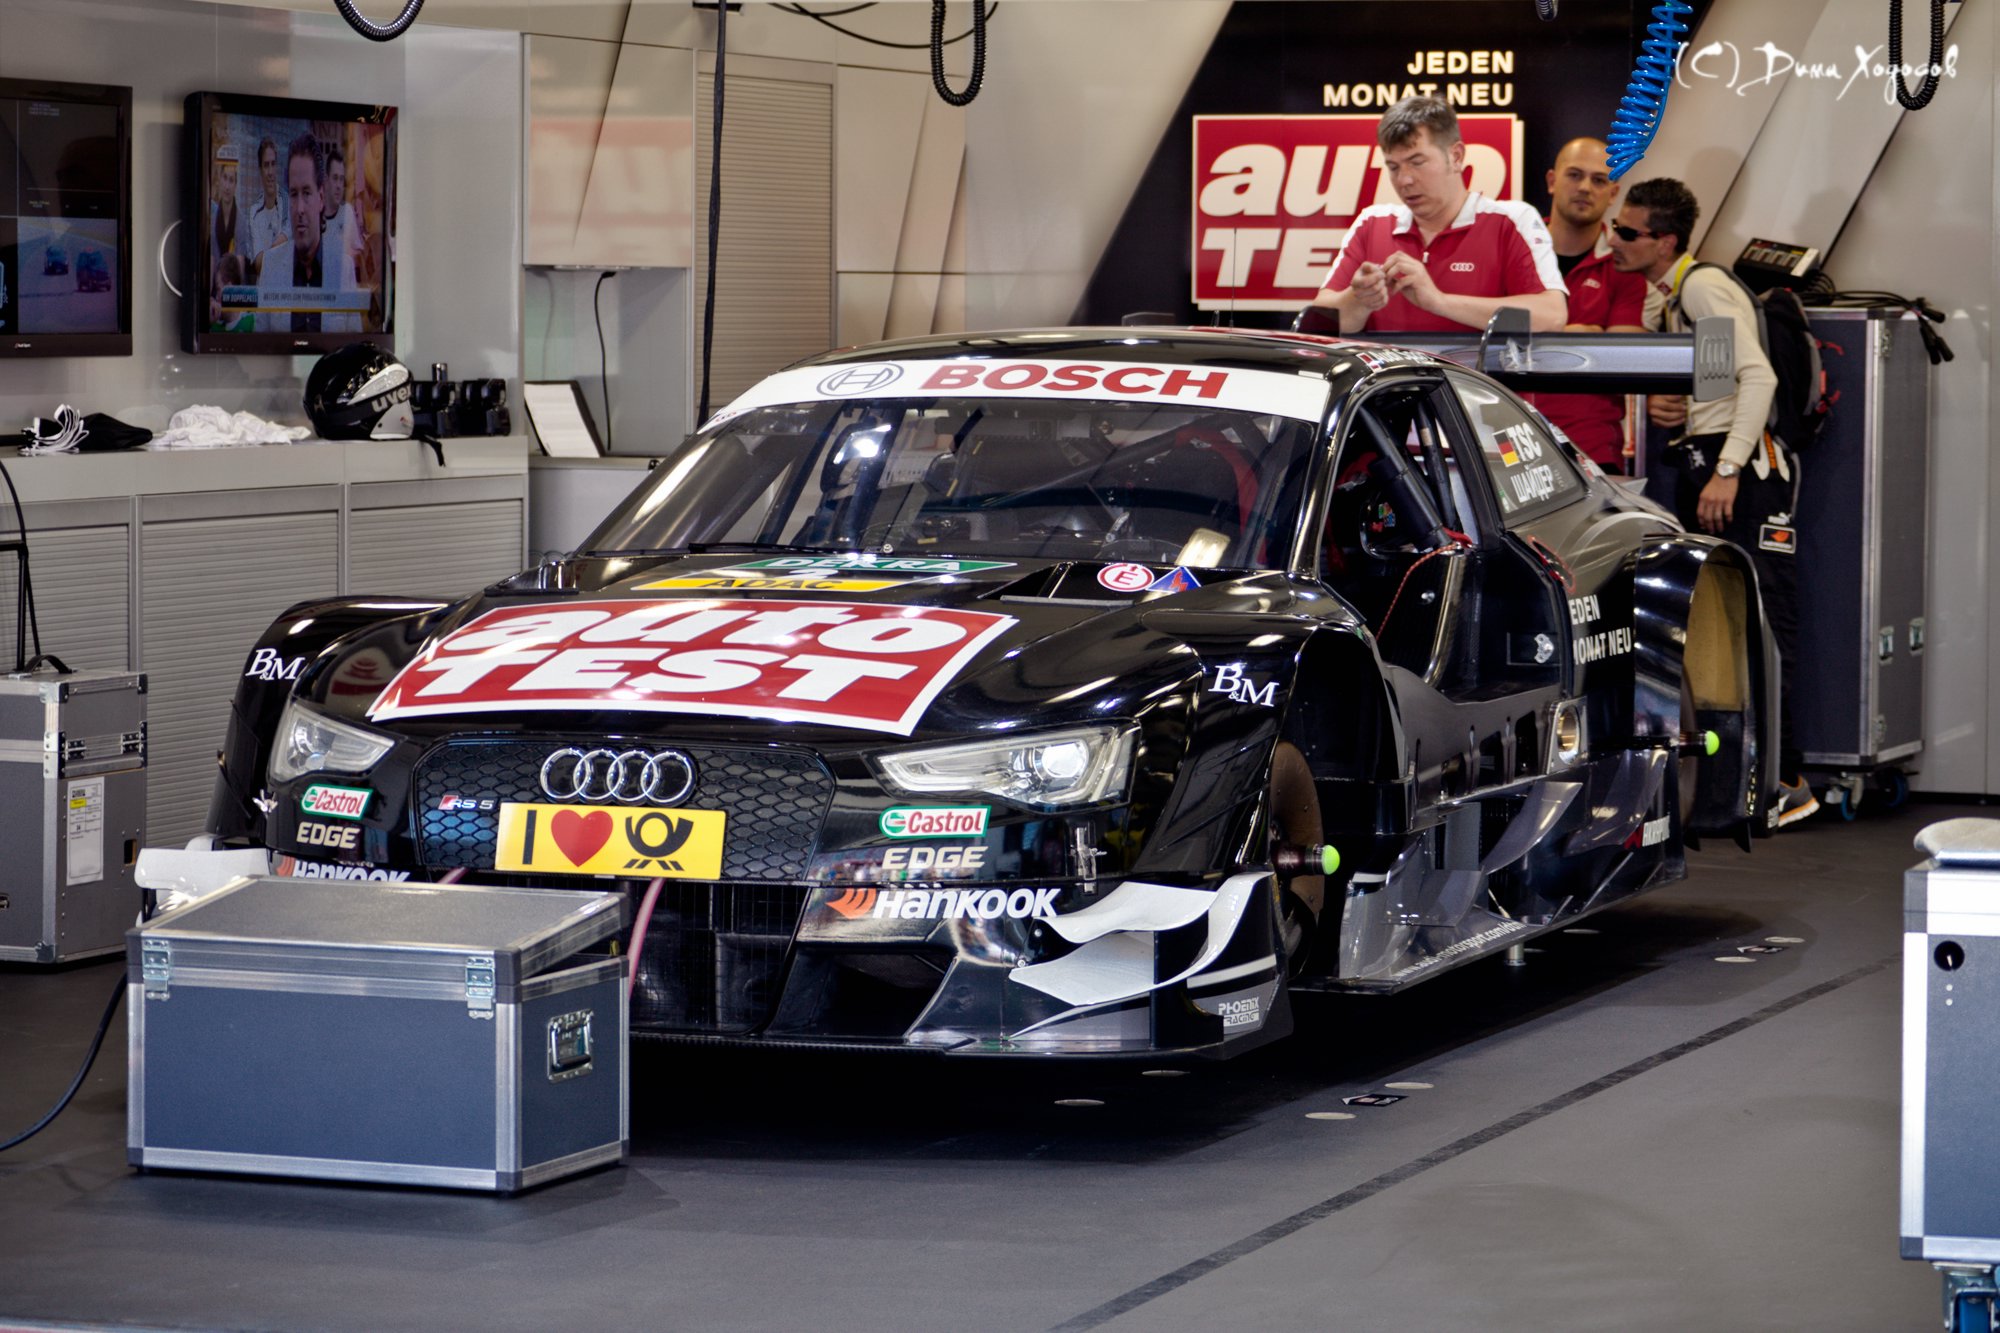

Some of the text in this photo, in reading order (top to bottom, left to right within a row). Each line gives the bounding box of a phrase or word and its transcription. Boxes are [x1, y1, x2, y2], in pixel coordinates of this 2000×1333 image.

[1407, 50, 1514, 75] JEDEN
[1446, 83, 1514, 107] NEU
[1201, 227, 1351, 288] TE
[918, 364, 1230, 399] BOSCH
[1506, 422, 1542, 461] TSC
[765, 558, 960, 571] DEKRA
[697, 579, 844, 590] ADAC
[1568, 594, 1601, 626] EDEN
[443, 607, 968, 653] auto
[1607, 626, 1632, 657] NEU
[245, 648, 306, 680] B&M
[414, 648, 918, 702] TEST
[1208, 664, 1280, 707] B&M
[314, 789, 364, 815] Castrol
[296, 821, 361, 848] EDGE
[522, 809, 537, 865] I
[907, 811, 982, 835] Castrol
[881, 845, 989, 870] EDGE
[1218, 997, 1260, 1016] PHOENIX
[1223, 1011, 1257, 1026] RACING
